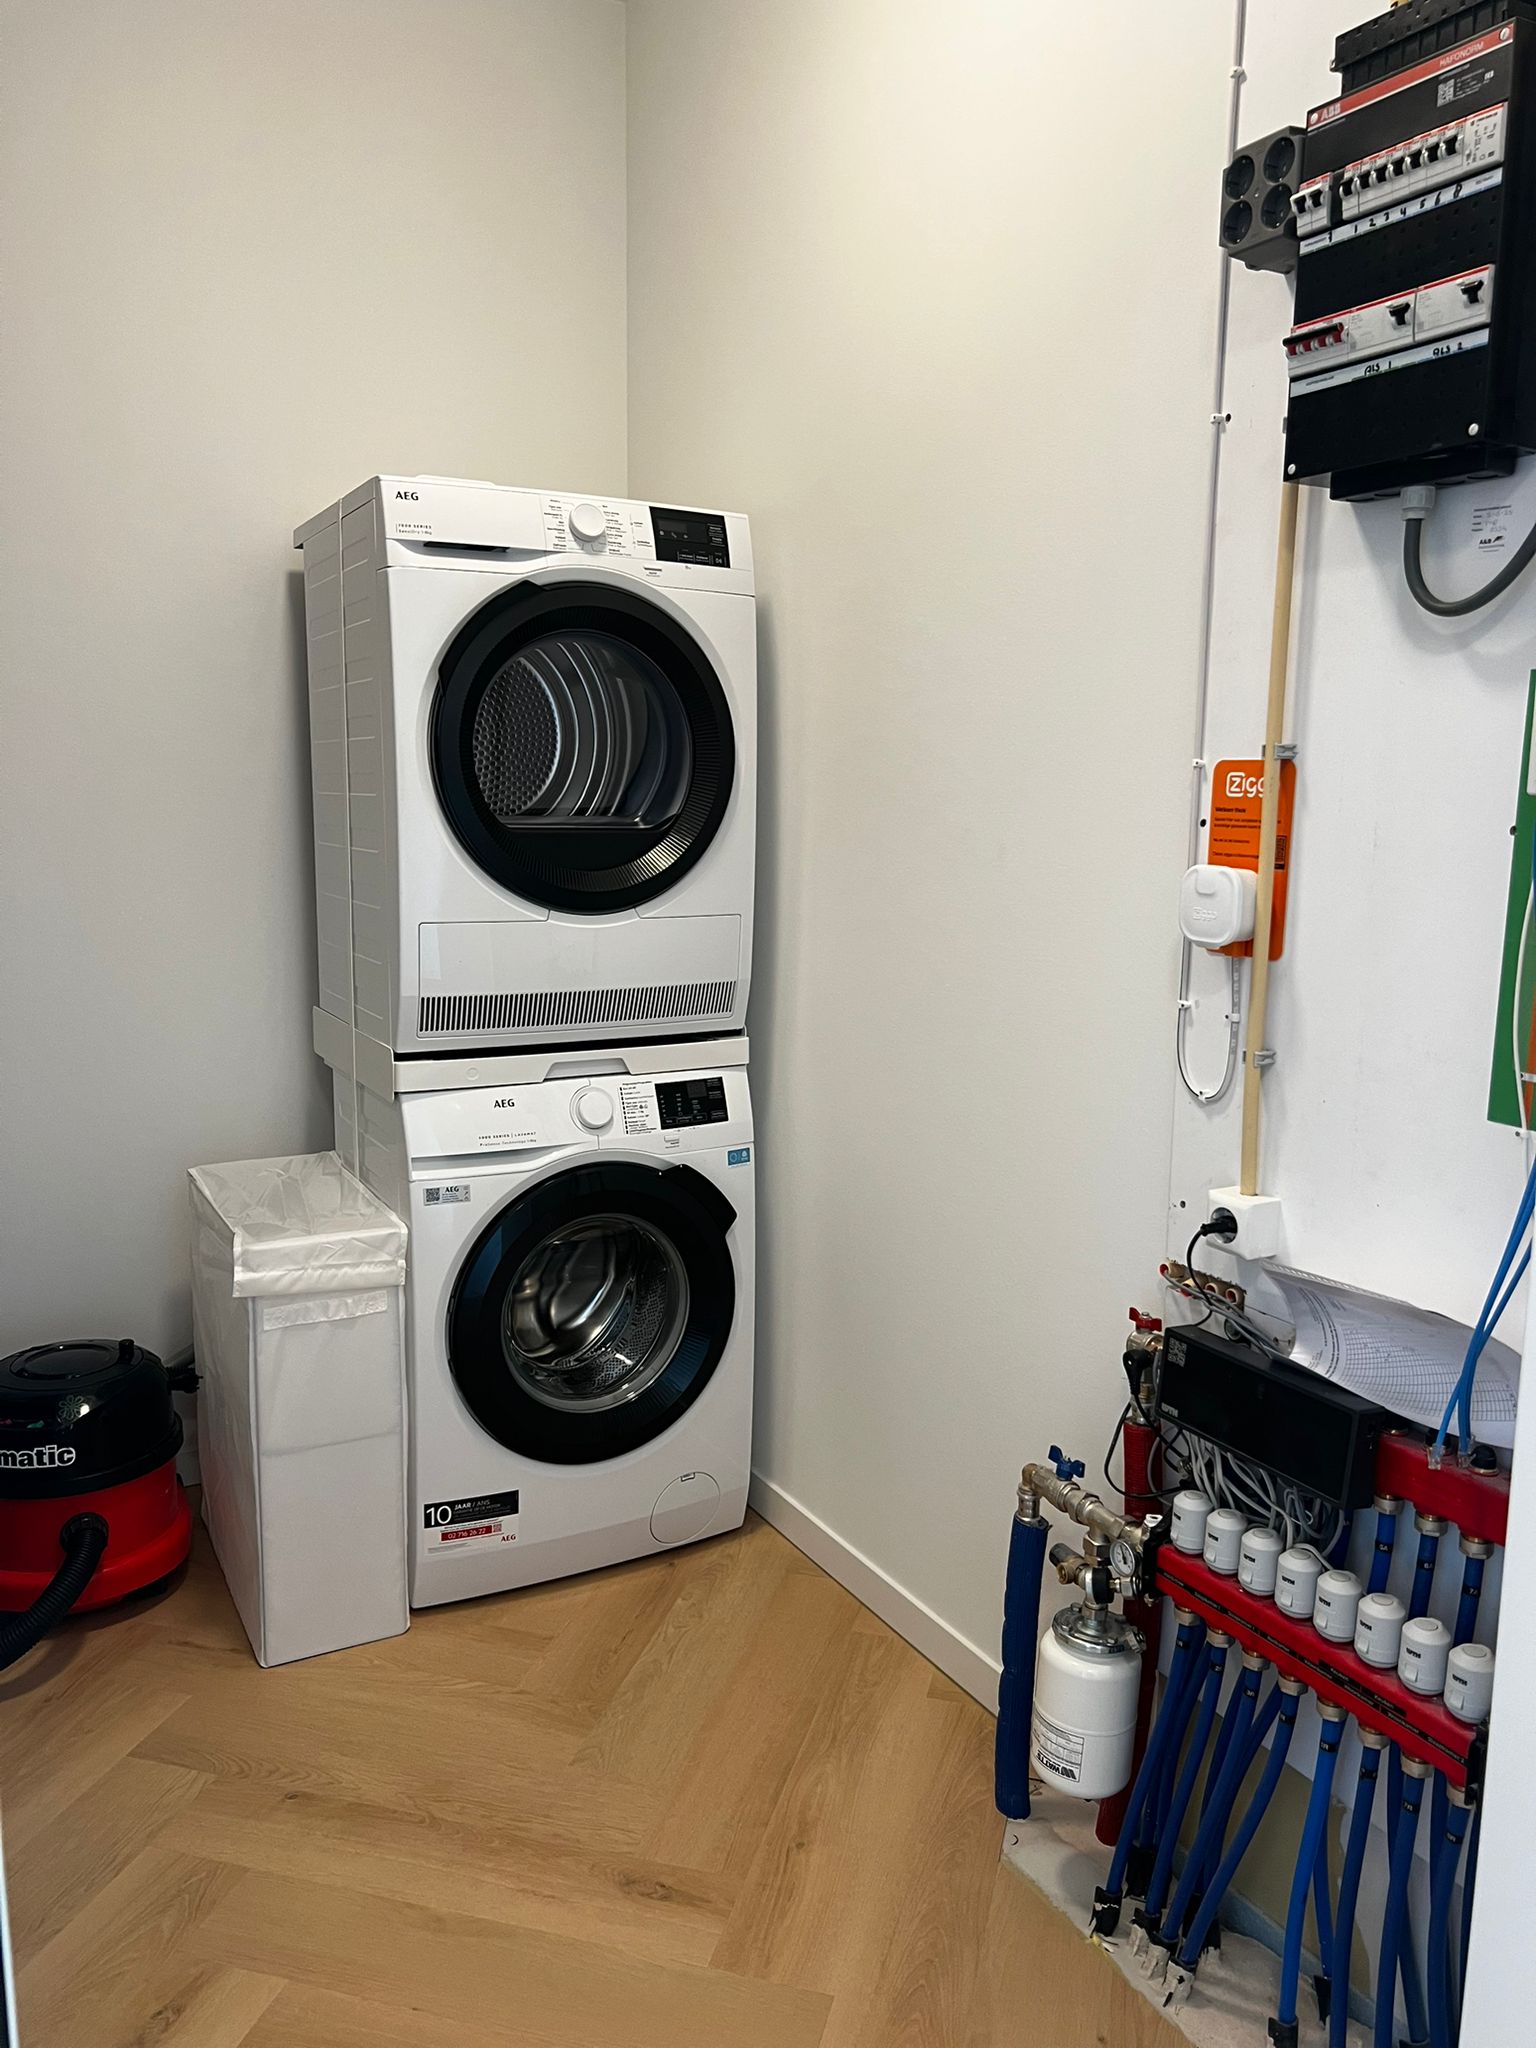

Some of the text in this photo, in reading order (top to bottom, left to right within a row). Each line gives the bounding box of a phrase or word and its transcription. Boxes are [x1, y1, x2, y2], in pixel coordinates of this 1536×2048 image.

[1320, 102, 1341, 121] ABB
[1368, 217, 1377, 227] 2
[1400, 206, 1407, 217] 4
[1419, 197, 1427, 209] 5
[1434, 191, 1442, 206] 6
[395, 490, 419, 501] AEG
[493, 1098, 516, 1109] AEG
[454, 1502, 472, 1511] JAAR
[425, 1505, 452, 1526] 10
[500, 1534, 517, 1542] AEG
[1036, 1752, 1061, 1775] WATTS
